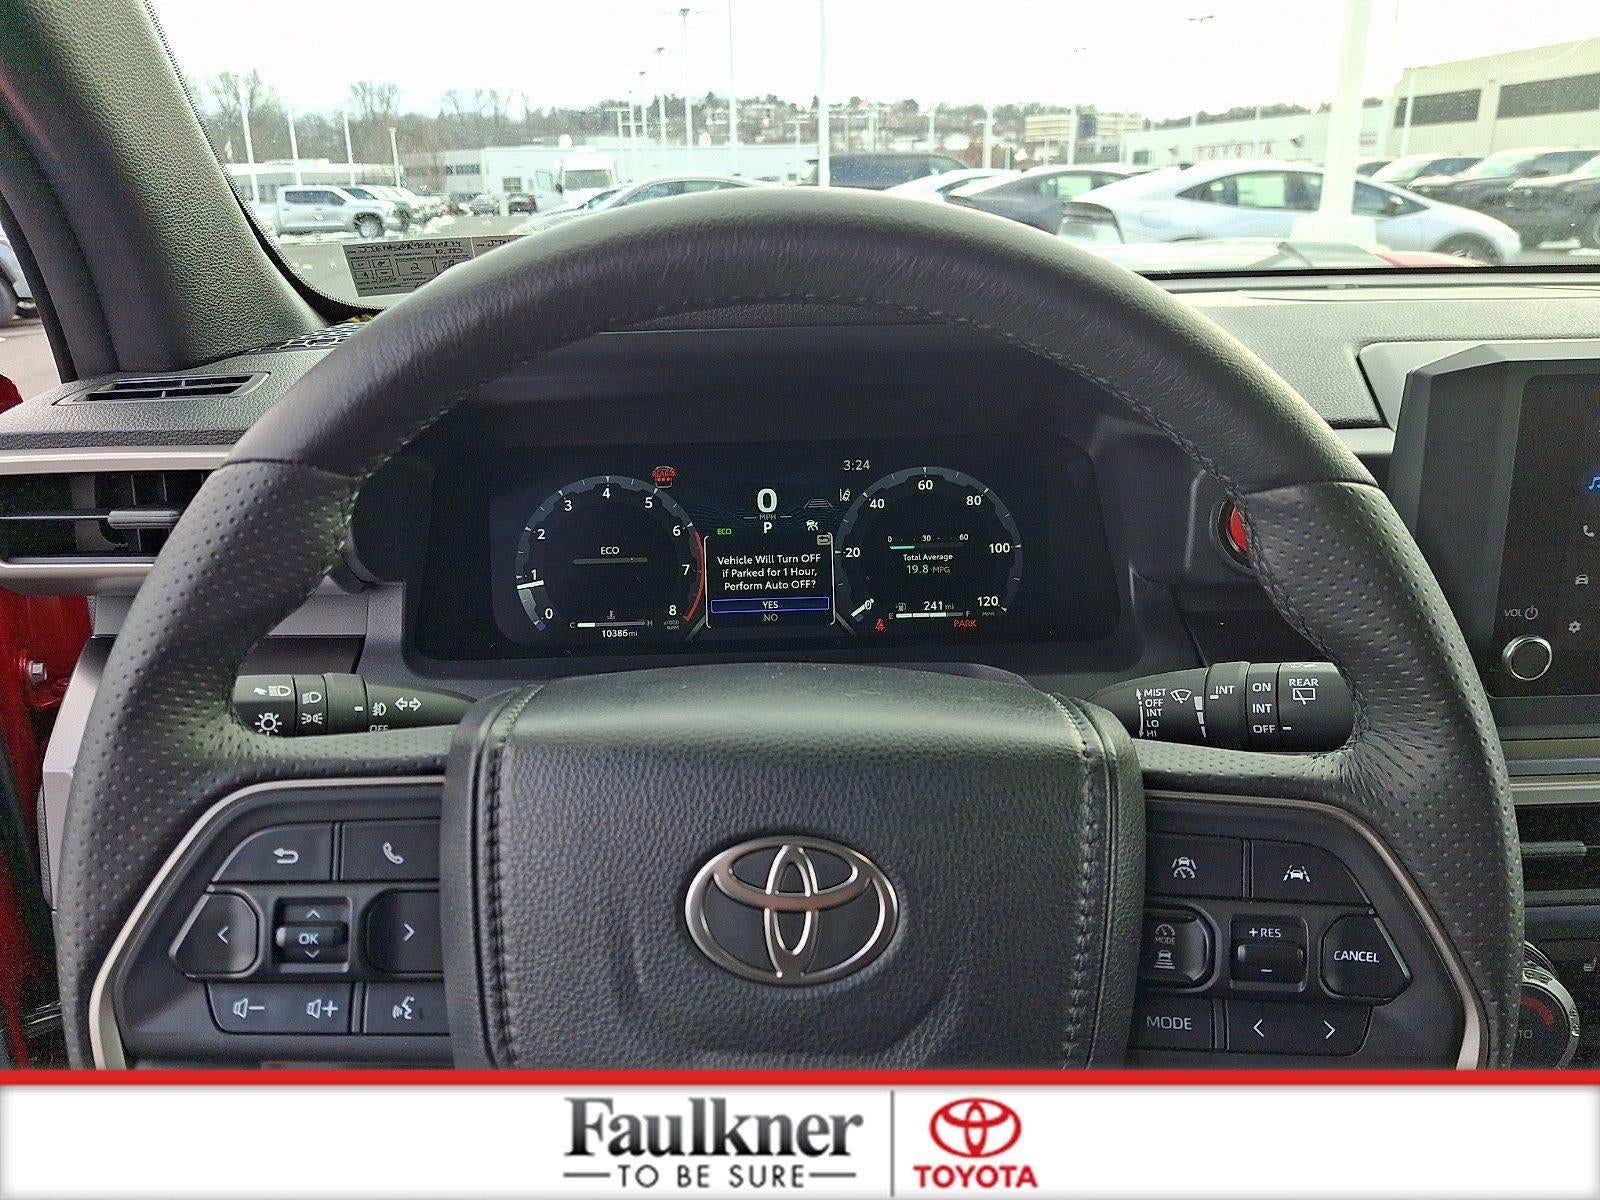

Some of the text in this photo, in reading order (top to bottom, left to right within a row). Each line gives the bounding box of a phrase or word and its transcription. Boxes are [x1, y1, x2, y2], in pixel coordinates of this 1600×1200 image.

[843, 459, 871, 471] 3:24
[917, 480, 934, 491] 60
[601, 487, 611, 499] 4
[563, 499, 573, 512] 3
[643, 497, 653, 509] 5
[757, 488, 778, 513] 0
[868, 498, 885, 509] 40
[965, 494, 982, 506] 80
[672, 525, 681, 537] 6
[763, 521, 773, 534] P
[537, 528, 546, 540] 2
[887, 535, 893, 543] 0
[922, 534, 932, 542] 30
[958, 533, 969, 541] 60
[600, 546, 620, 555] ECO
[845, 546, 861, 558] 20
[988, 542, 1011, 554] 100
[717, 554, 821, 565] Vehicle Will Turn OFF
[903, 553, 954, 562] Total Average
[531, 569, 537, 581] 1
[681, 564, 690, 576] 7
[722, 567, 818, 578] if Parked for 1 Hour,
[906, 565, 951, 574] 19.8 MPG
[724, 579, 816, 591] Perform Auto OFF?
[762, 600, 779, 609] YES
[923, 600, 943, 611] 241
[977, 595, 1000, 607] 120
[544, 607, 554, 620] 0
[668, 604, 677, 616] 8
[1504, 608, 1522, 619] VOL
[763, 613, 779, 622] NO
[888, 612, 894, 620] E
[569, 621, 576, 629] C
[646, 619, 653, 627] H
[953, 619, 977, 628] PARK
[601, 629, 628, 638] 10386
[1252, 682, 1272, 692] ON
[1288, 678, 1319, 687] REAR
[1143, 688, 1167, 697] MIST
[1215, 685, 1235, 695] INT
[1145, 698, 1164, 707] OFF
[1146, 707, 1163, 717] INT
[1252, 703, 1273, 714] INT
[1146, 719, 1160, 728] LO
[1252, 724, 1276, 733] OFF
[1146, 729, 1158, 738] HI
[298, 932, 319, 945] OK
[1153, 936, 1176, 946] MODE
[1333, 950, 1380, 964] CANCEL
[1146, 1016, 1193, 1031] MODE
